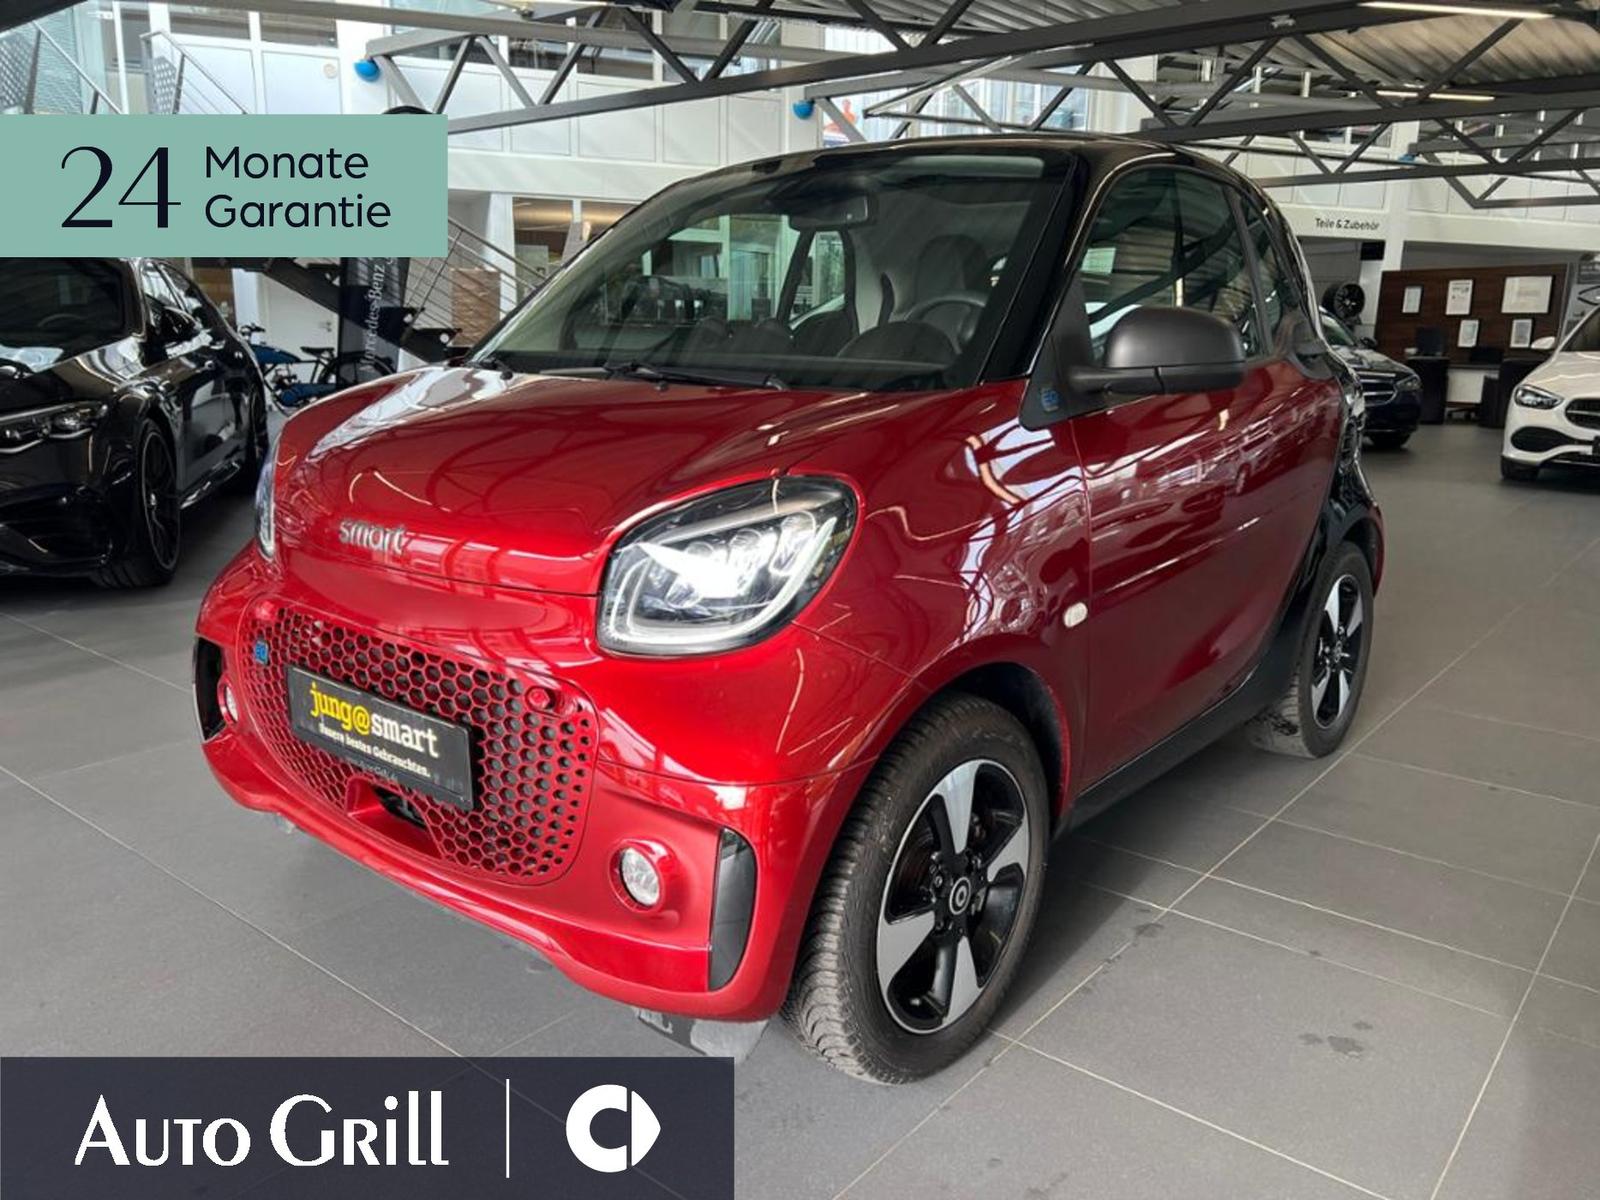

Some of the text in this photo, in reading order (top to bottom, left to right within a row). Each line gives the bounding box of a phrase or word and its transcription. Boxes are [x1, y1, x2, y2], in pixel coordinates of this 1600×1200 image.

[1315, 217, 1335, 229] Teile
[339, 518, 405, 555] smart
[309, 681, 440, 759] jung@smart
